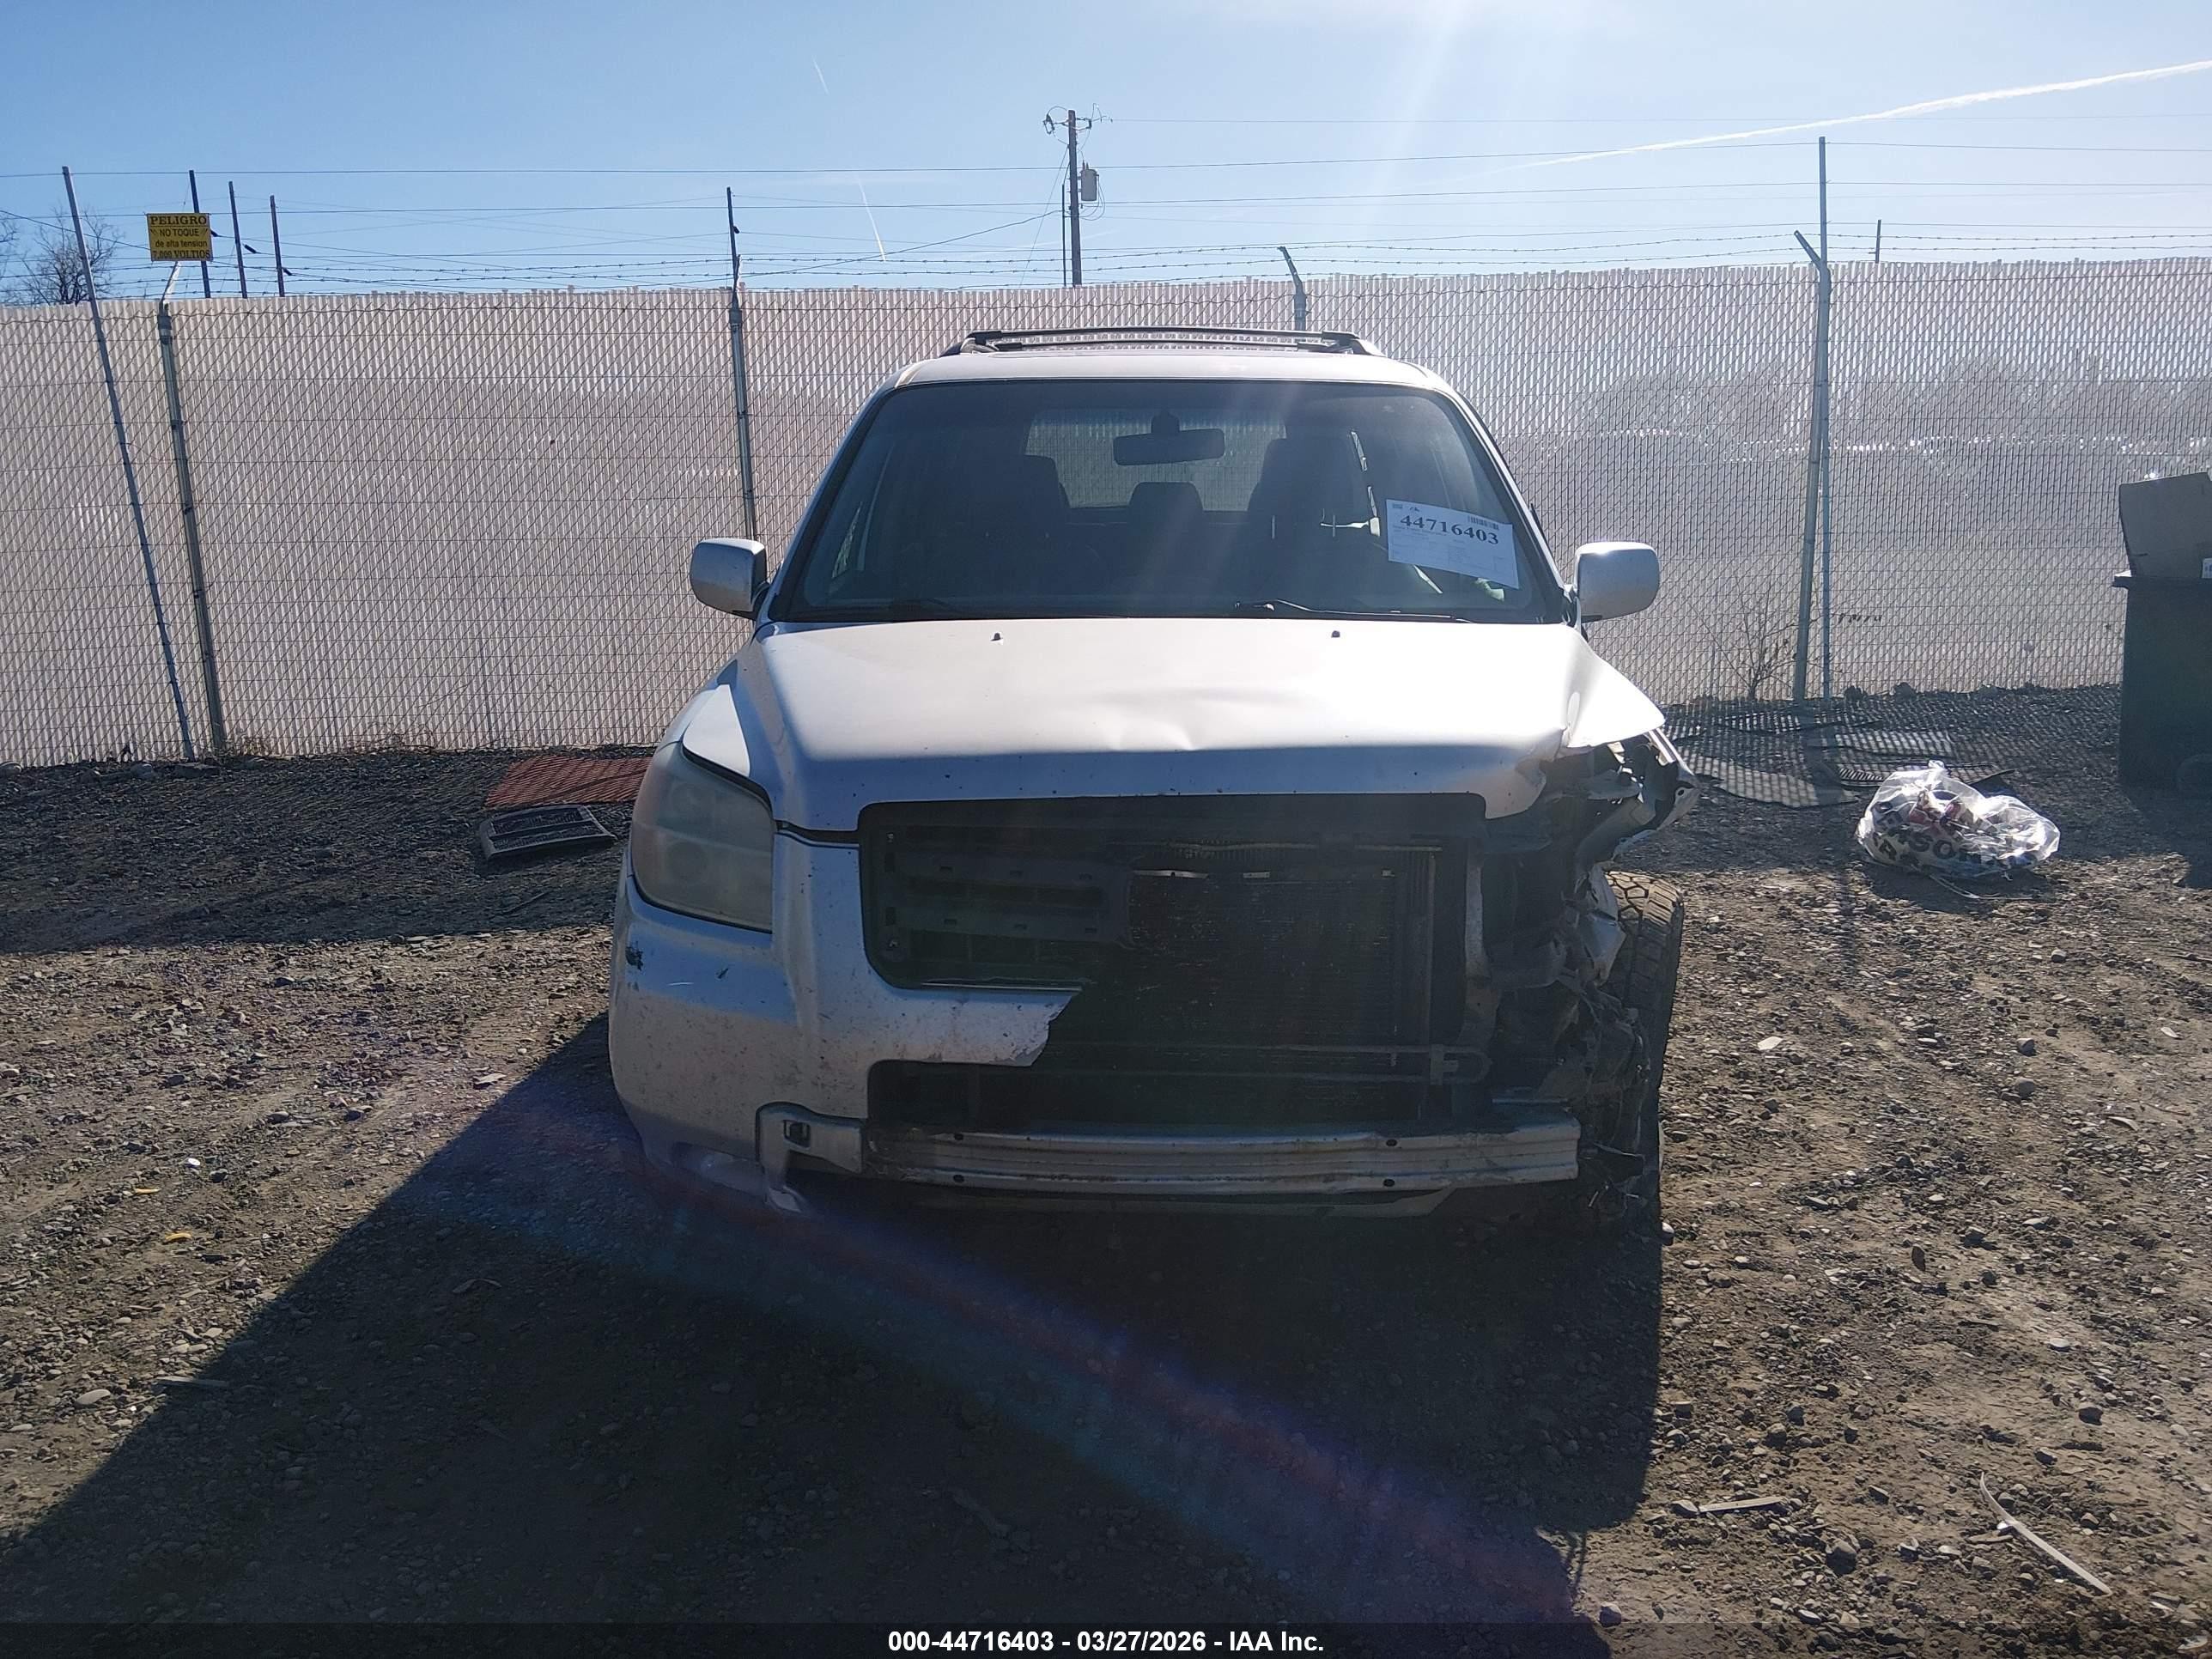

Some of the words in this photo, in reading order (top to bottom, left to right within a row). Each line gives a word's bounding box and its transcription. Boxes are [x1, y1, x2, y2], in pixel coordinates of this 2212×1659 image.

[149, 216, 207, 225] PELIGRO
[160, 228, 171, 237] NO
[172, 228, 199, 237] TOQUE
[173, 250, 210, 258] VOLTIOS
[1401, 515, 1498, 544] 44716403
